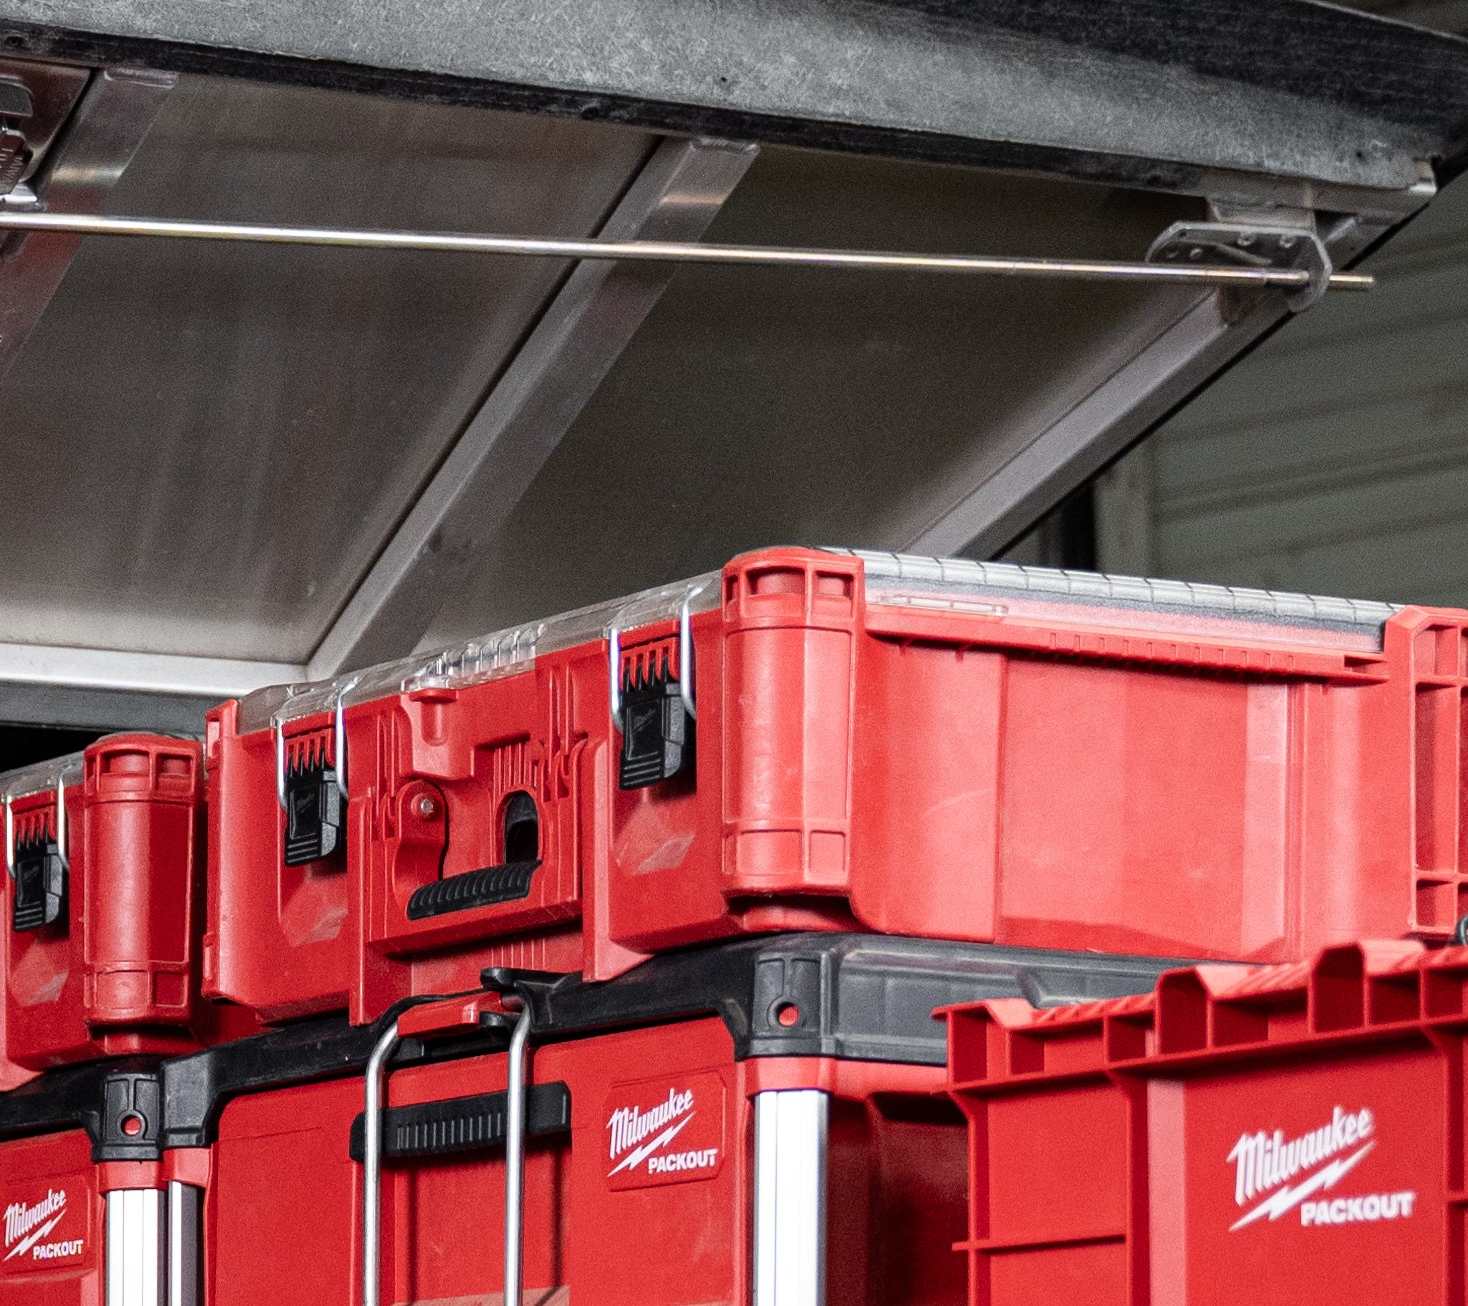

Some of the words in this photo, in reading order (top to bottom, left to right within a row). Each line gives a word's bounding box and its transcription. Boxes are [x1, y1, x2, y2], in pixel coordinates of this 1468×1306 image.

[606, 1087, 695, 1160] Milwaukee
[648, 1148, 719, 1175] PACKOUT
[1226, 1105, 1377, 1207] Milwaukee
[3, 1188, 67, 1248] Milwaukee
[1300, 1191, 1417, 1227] PACKOUT
[33, 1239, 84, 1261] PACKOUT
